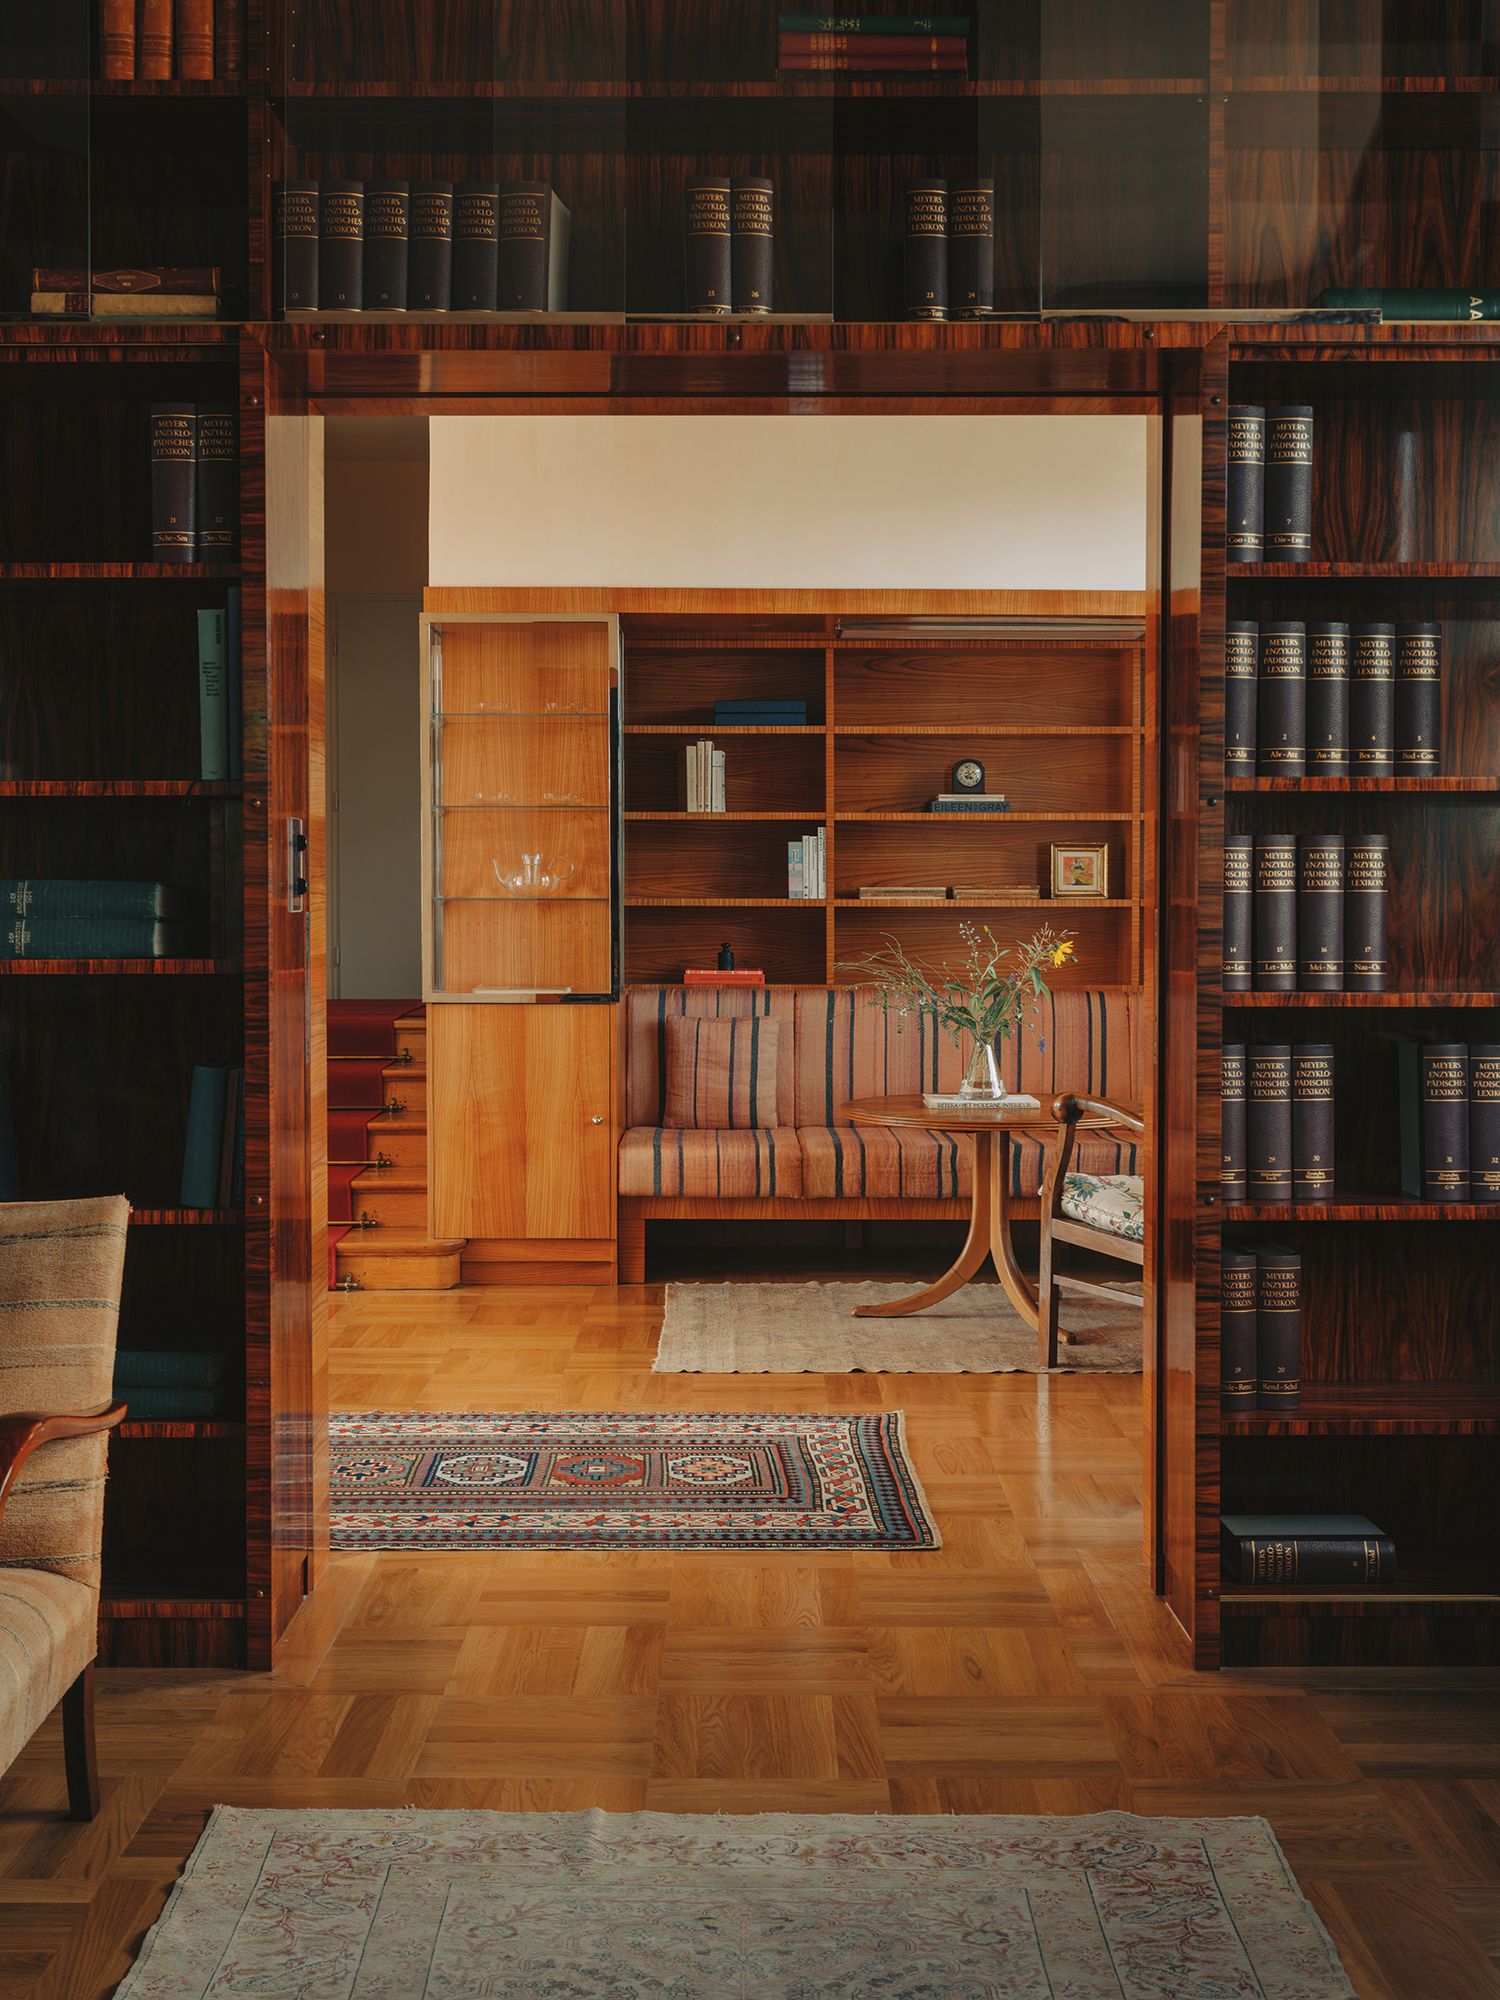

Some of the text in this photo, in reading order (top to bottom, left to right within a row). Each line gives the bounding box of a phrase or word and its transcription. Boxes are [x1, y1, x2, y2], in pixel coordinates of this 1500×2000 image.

[739, 194, 768, 202] MEYERS
[693, 222, 727, 230] LEXIKON
[737, 222, 770, 231] LEXIKON
[934, 803, 1009, 812] EILEEN GRAY
